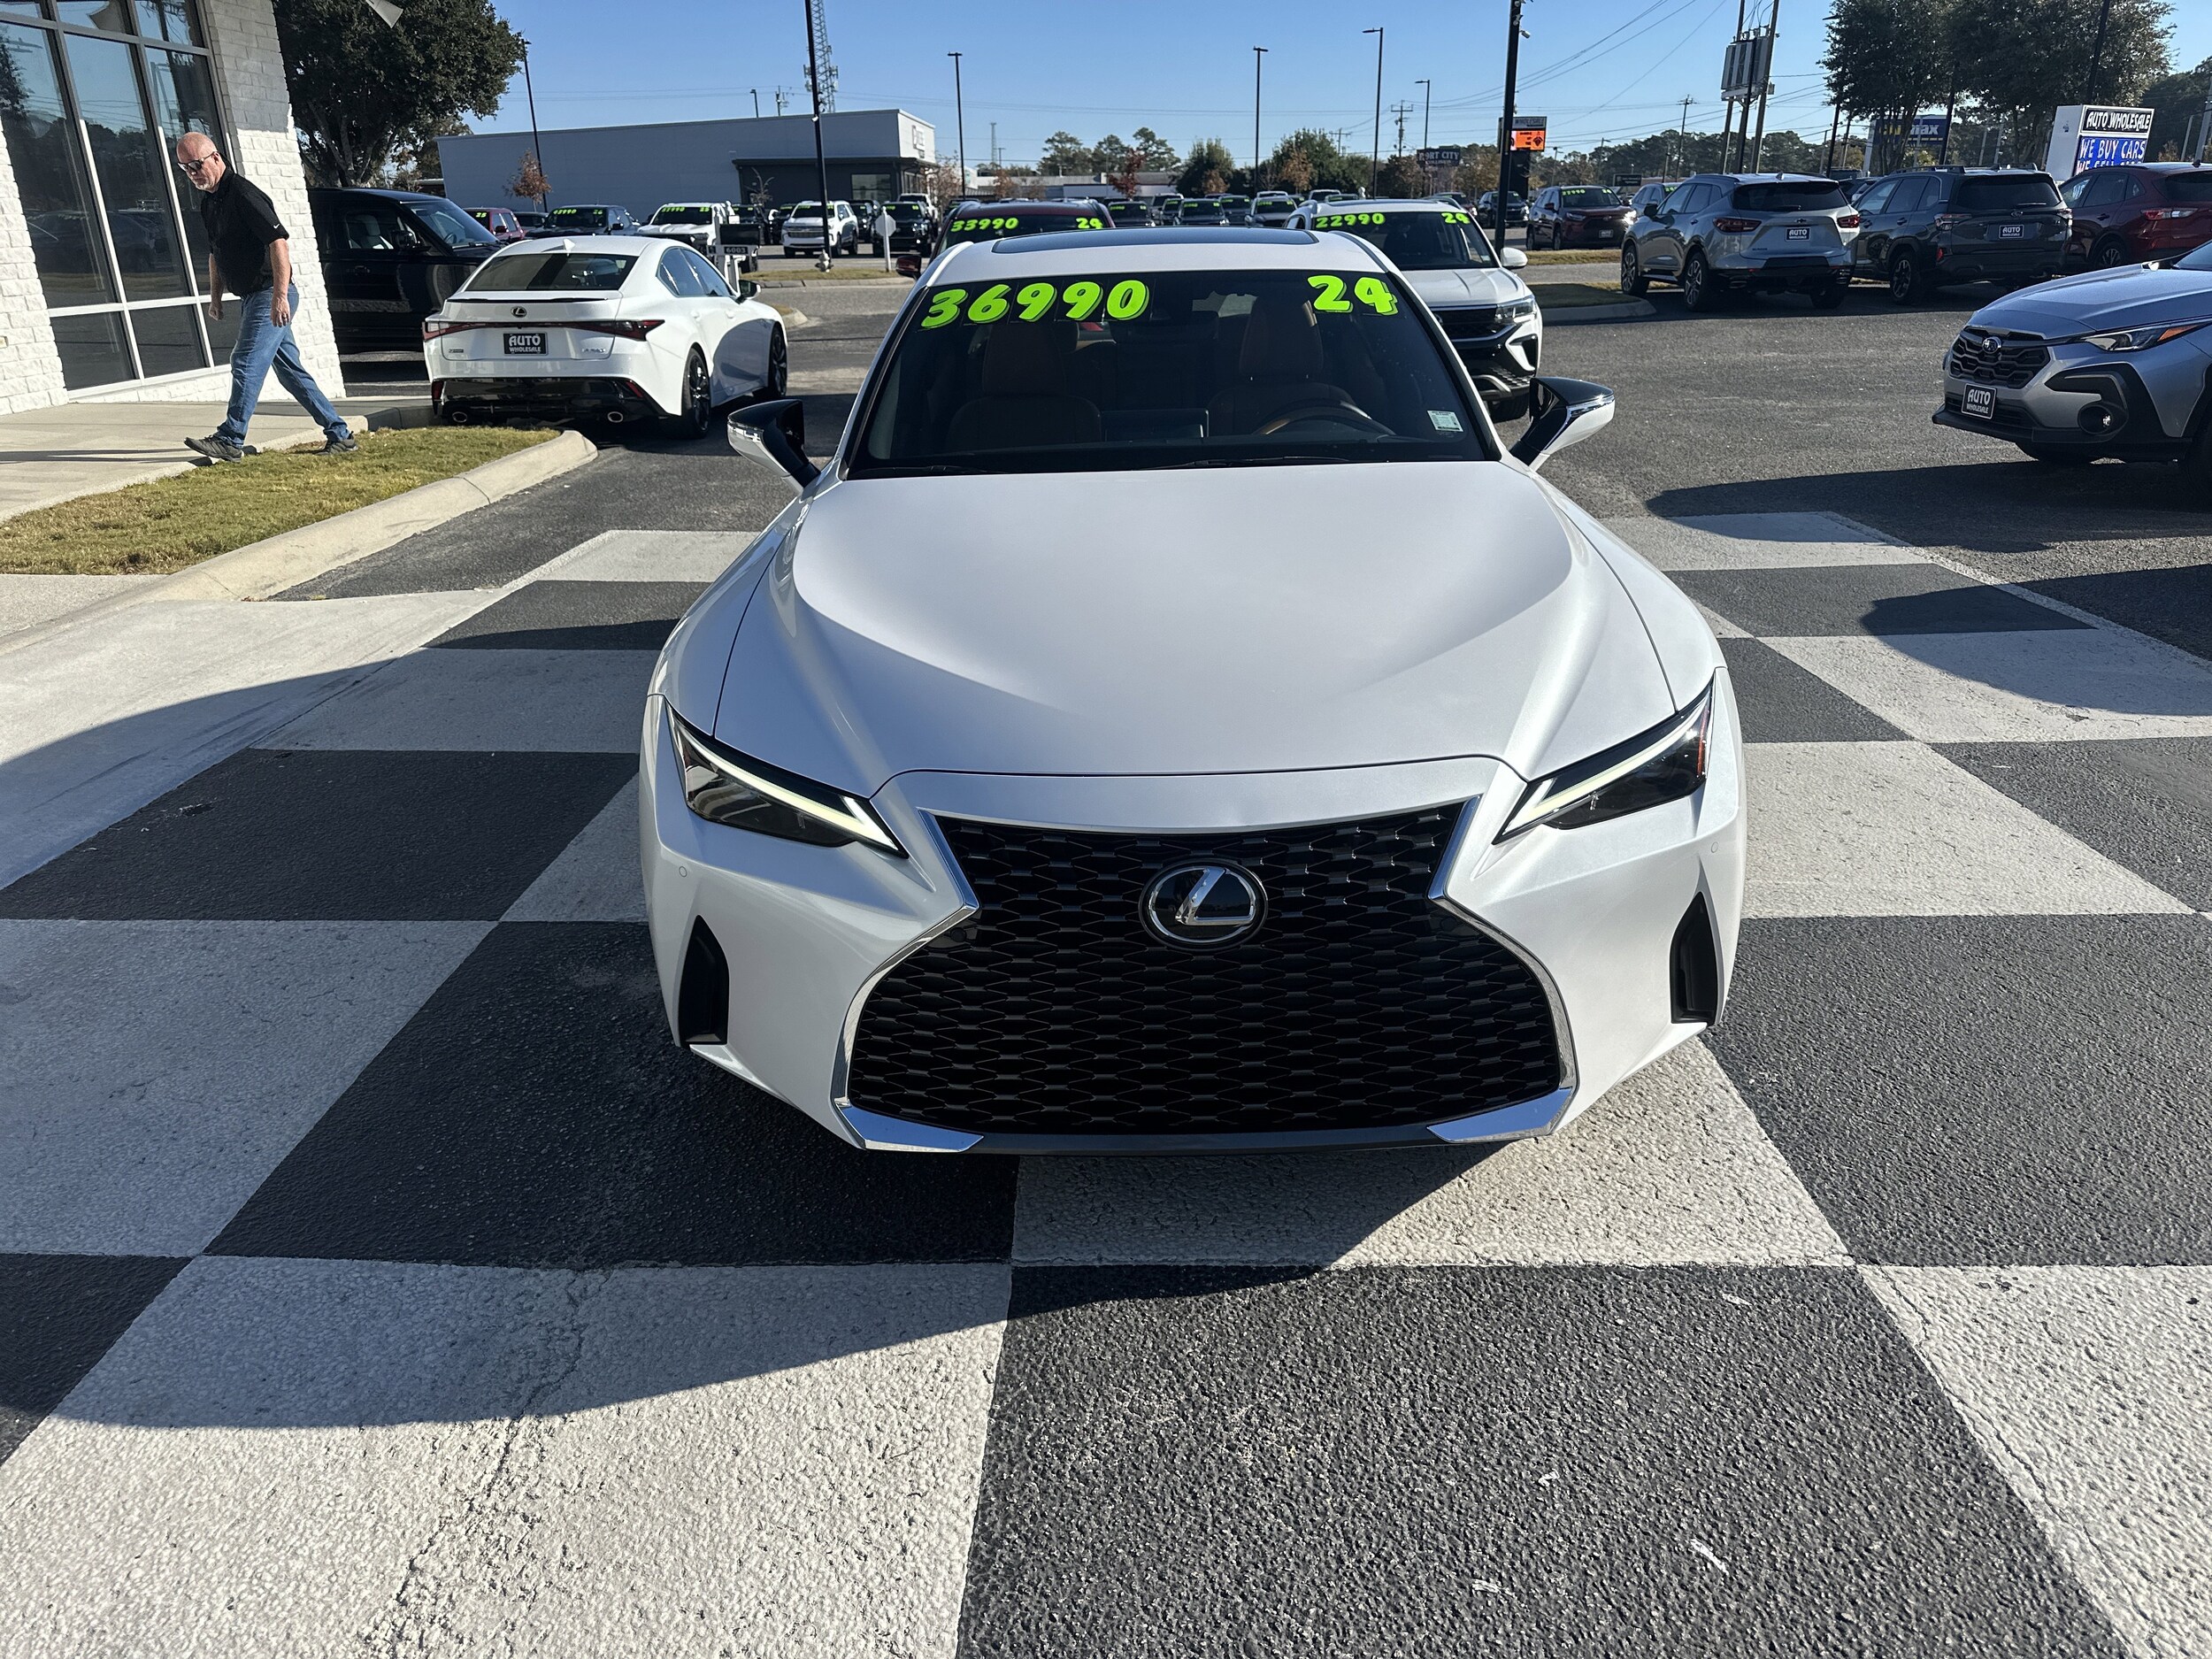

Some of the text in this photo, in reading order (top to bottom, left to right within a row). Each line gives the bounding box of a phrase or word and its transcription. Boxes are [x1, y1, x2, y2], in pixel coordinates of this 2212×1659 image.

[2085, 111, 2151, 132] AUTO WHOLESALE
[1418, 150, 1459, 160] PORT CITY
[2079, 138, 2147, 159] WE BUY CARS
[950, 218, 1102, 232] 33990 24
[1316, 212, 1470, 228] 22990 24
[920, 275, 1397, 328] 36990 24
[509, 335, 541, 346] AUTO
[1968, 389, 1991, 405] AUTO
